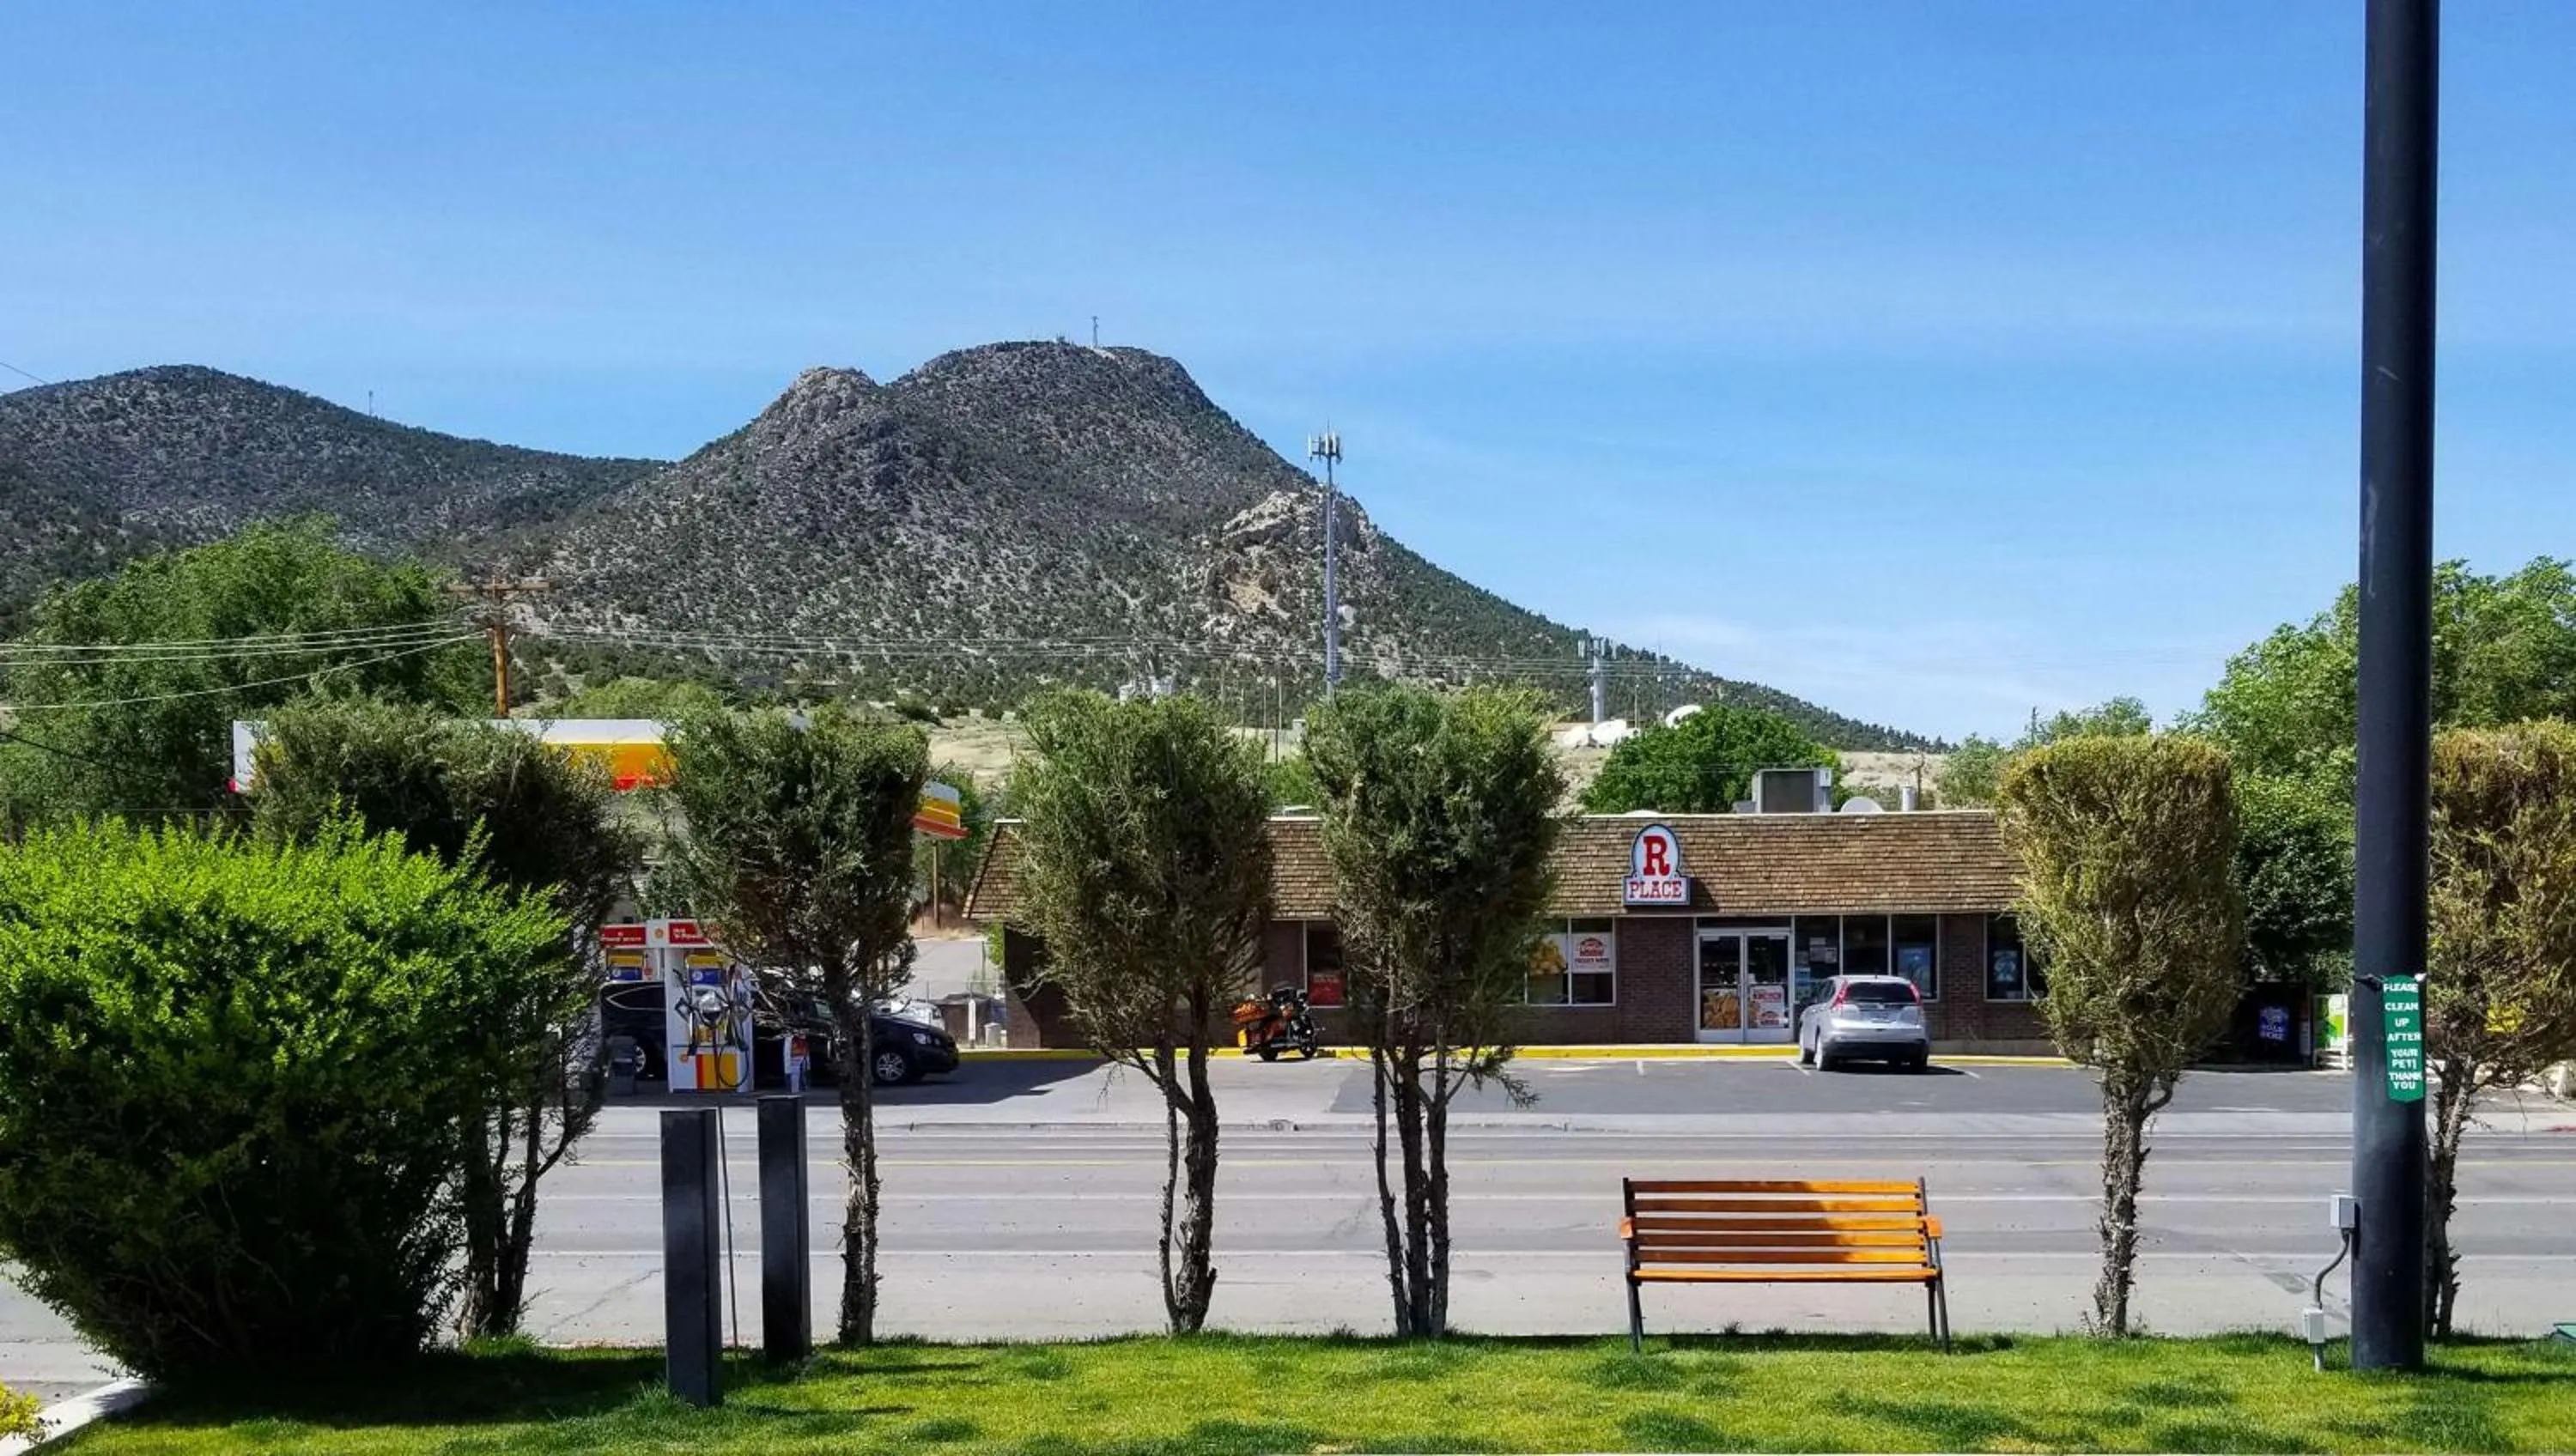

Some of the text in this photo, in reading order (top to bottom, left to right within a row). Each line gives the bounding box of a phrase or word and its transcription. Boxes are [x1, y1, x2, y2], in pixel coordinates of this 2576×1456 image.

[1643, 835, 1670, 876] R
[1629, 881, 1682, 899] PLACE
[2383, 983, 2419, 992] PLEASE
[2385, 1002, 2419, 1011] CLEAN
[2394, 1017, 2409, 1028] UP
[2387, 1033, 2421, 1041] AFTER
[2391, 1048, 2418, 1058] YOUR
[2388, 1071, 2422, 1081] THANK
[2392, 1081, 2416, 1089] YOU
